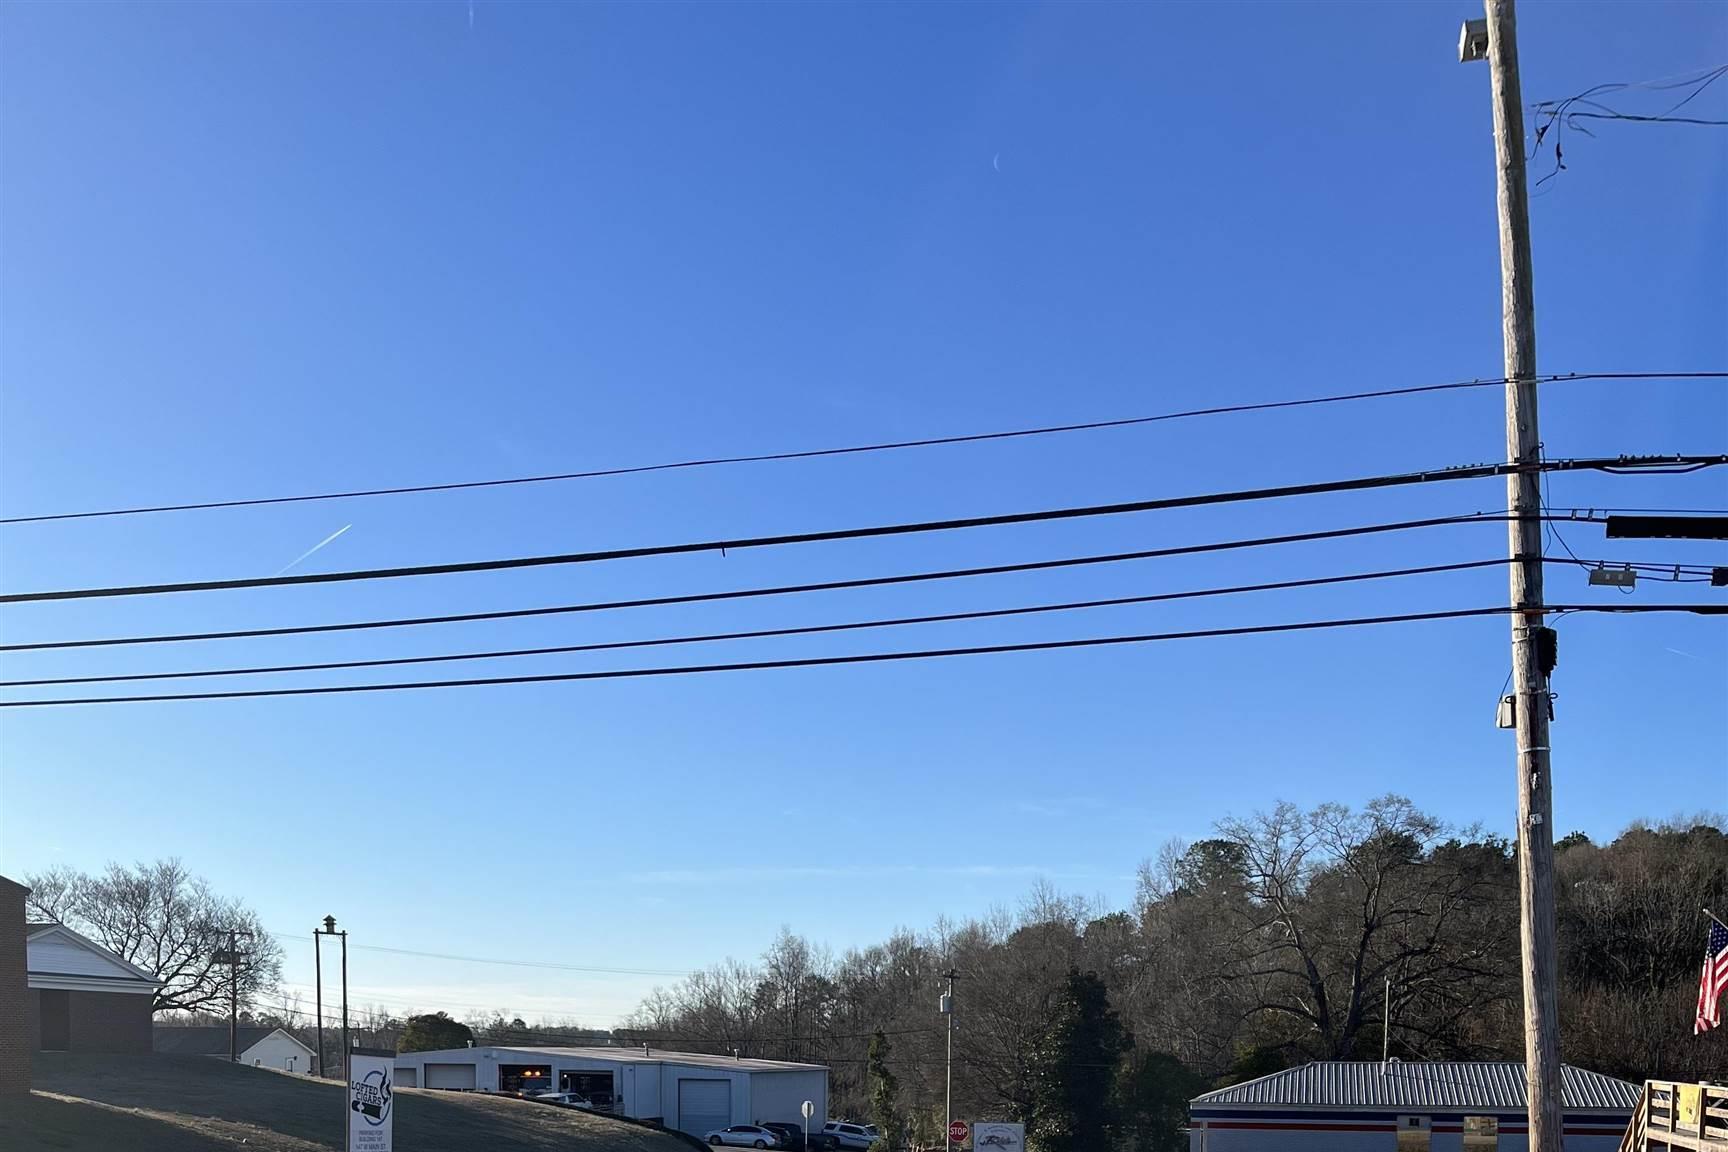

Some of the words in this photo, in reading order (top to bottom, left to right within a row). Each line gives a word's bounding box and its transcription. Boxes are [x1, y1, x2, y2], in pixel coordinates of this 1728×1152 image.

[352, 1080, 378, 1095] LOFTED
[356, 1092, 382, 1106] CIGARS
[949, 1127, 967, 1136] STOP
